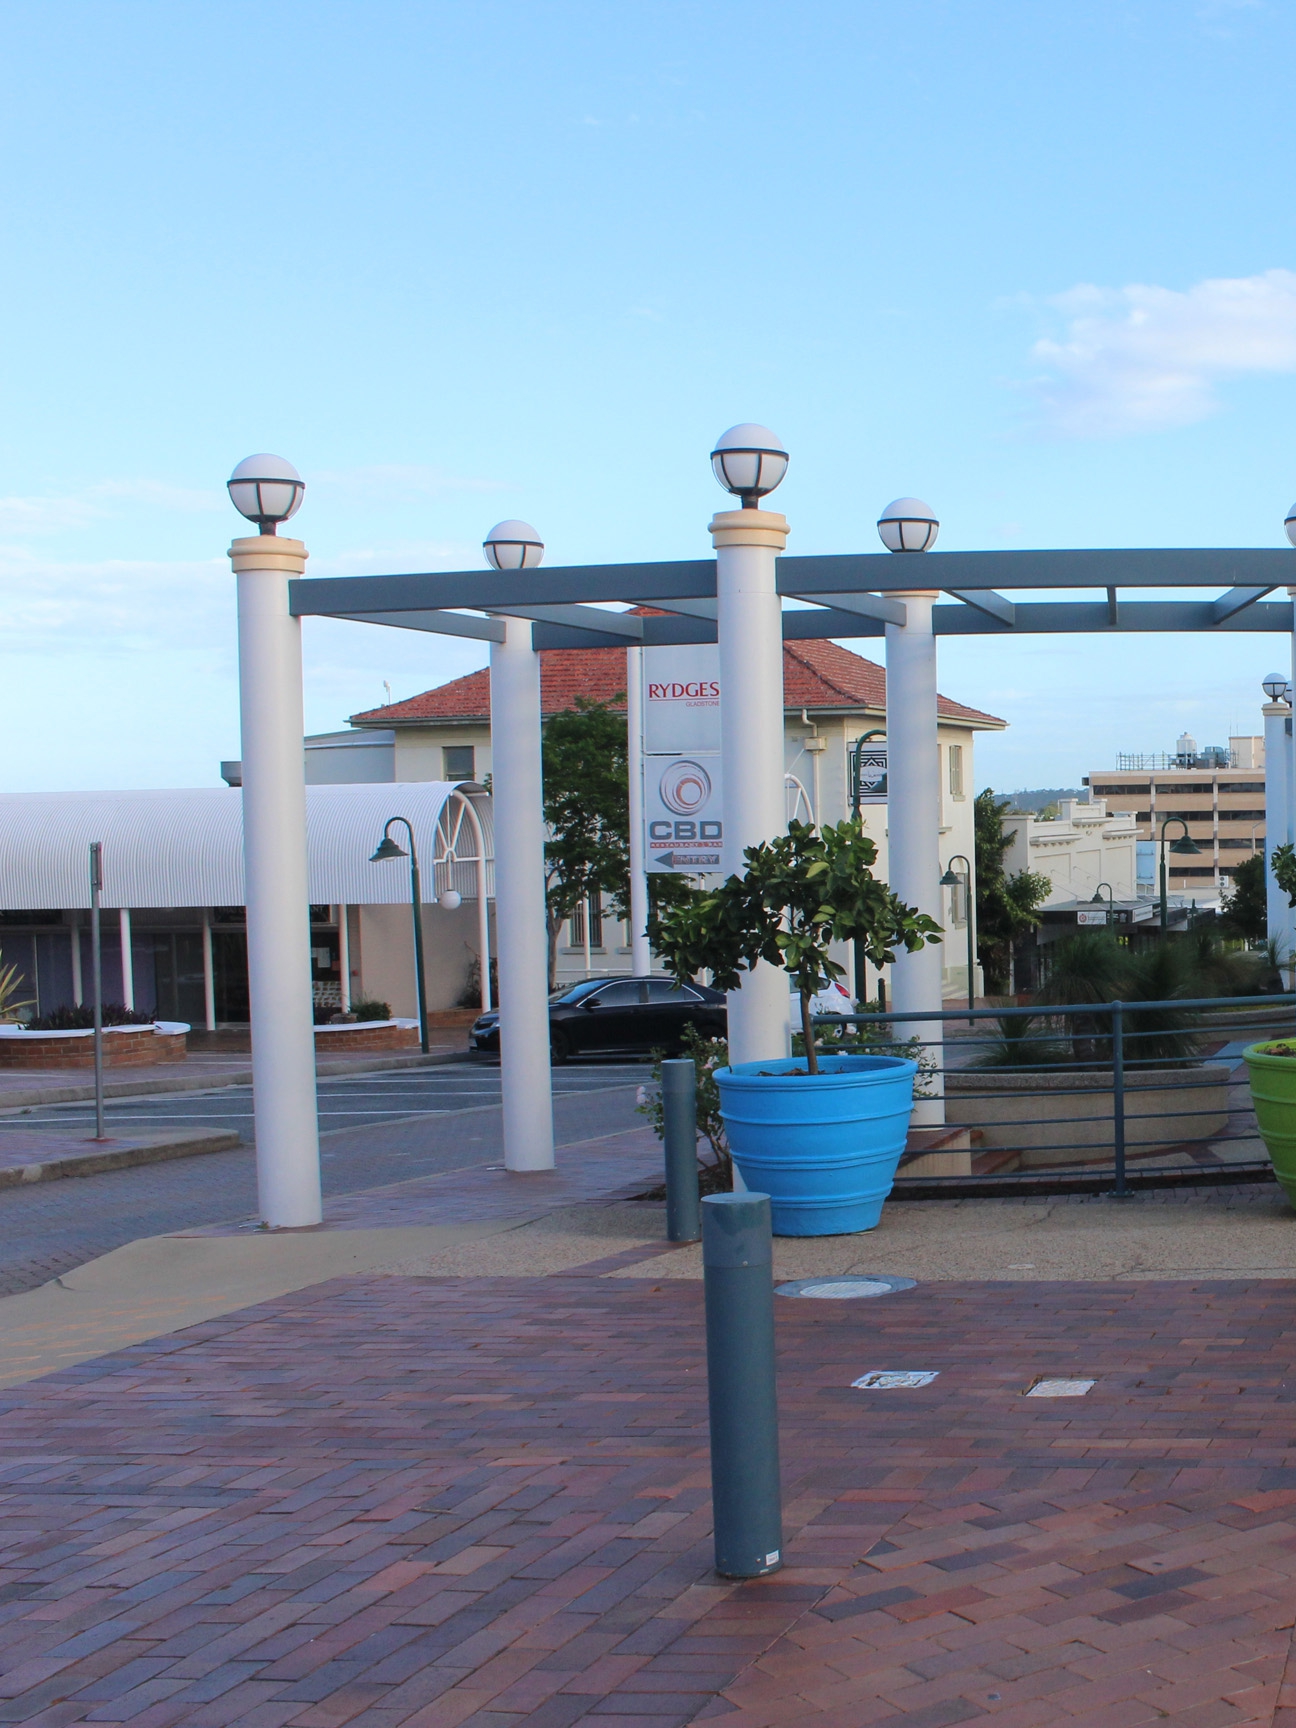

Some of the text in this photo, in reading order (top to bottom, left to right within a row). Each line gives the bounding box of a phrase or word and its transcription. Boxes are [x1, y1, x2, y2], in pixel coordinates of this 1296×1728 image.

[649, 682, 720, 698] RYDGES
[650, 821, 722, 840] CBD
[675, 855, 718, 865] ENTRY
